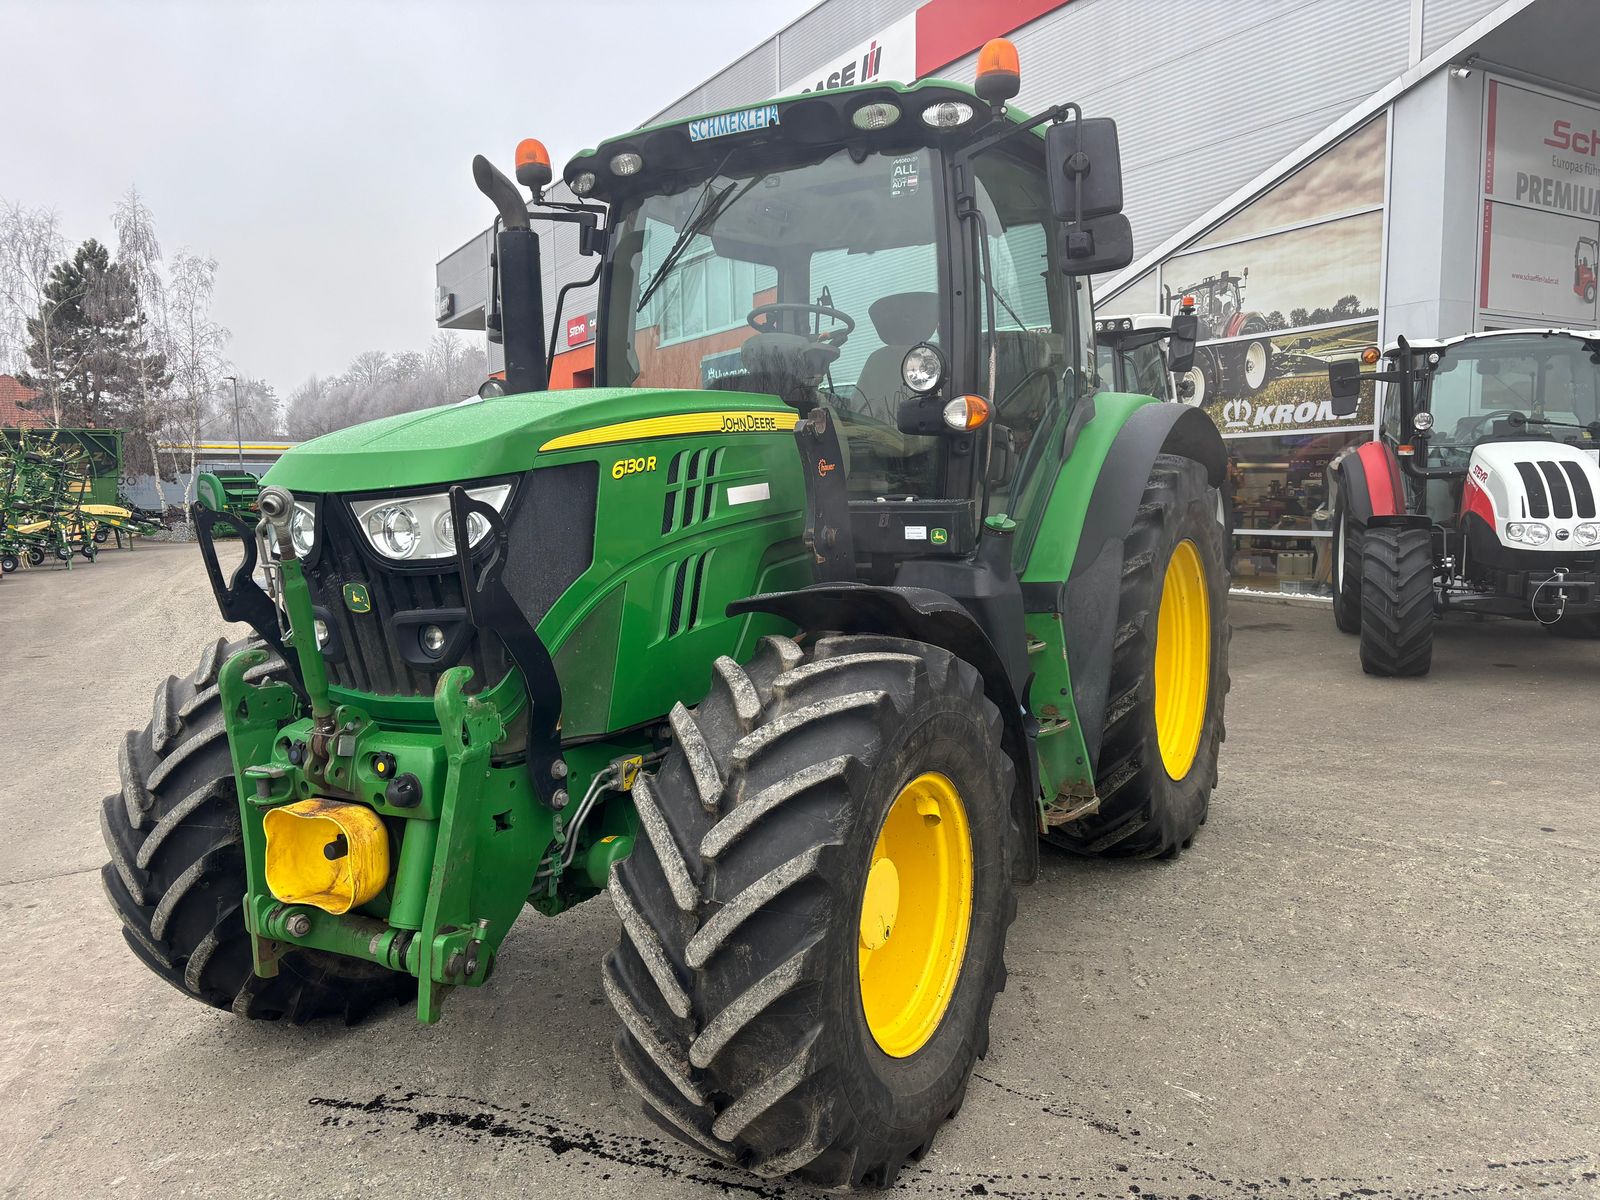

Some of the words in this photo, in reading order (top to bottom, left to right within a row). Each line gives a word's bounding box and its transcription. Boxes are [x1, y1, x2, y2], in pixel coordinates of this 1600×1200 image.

[894, 164, 917, 177] ALL
[1552, 155, 1583, 174] Europas
[892, 181, 906, 189] AUT
[569, 323, 585, 337] STEYR
[720, 415, 747, 432] JOHN
[746, 415, 778, 431] DEERE
[612, 457, 646, 480] 6130
[646, 455, 657, 472] R
[1473, 464, 1489, 484] STEYR
